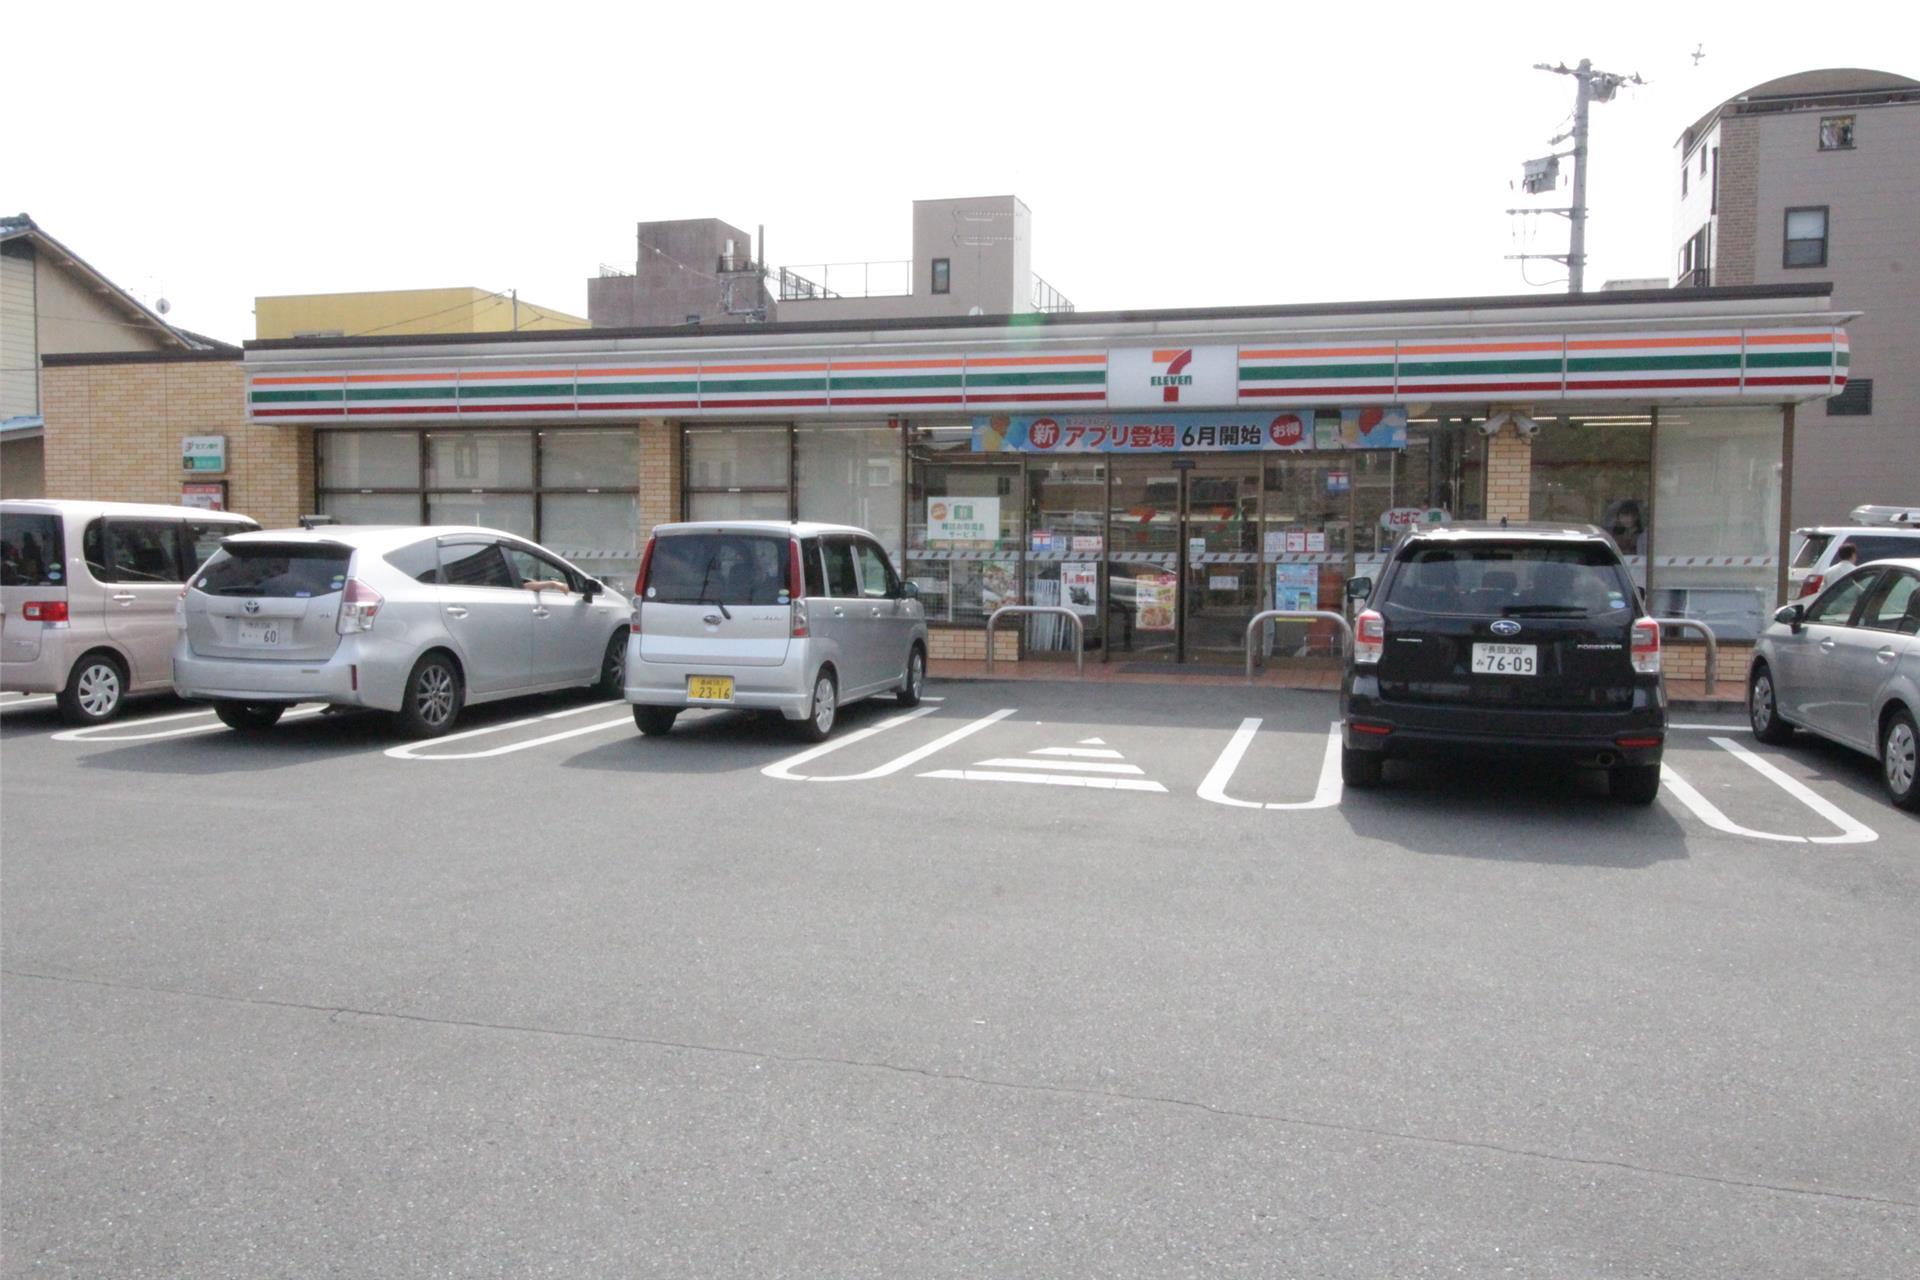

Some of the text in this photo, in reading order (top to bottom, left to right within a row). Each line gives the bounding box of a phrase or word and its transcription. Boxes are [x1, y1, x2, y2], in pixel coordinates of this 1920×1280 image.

[1152, 349, 1192, 402] 7
[1033, 423, 1262, 448] 新 アプリ登場 6月開始
[1272, 421, 1301, 439] お得
[1389, 511, 1420, 525] たばこ
[263, 630, 277, 643] 60
[1486, 654, 1534, 673] 76-09
[699, 686, 730, 699] 23-16
